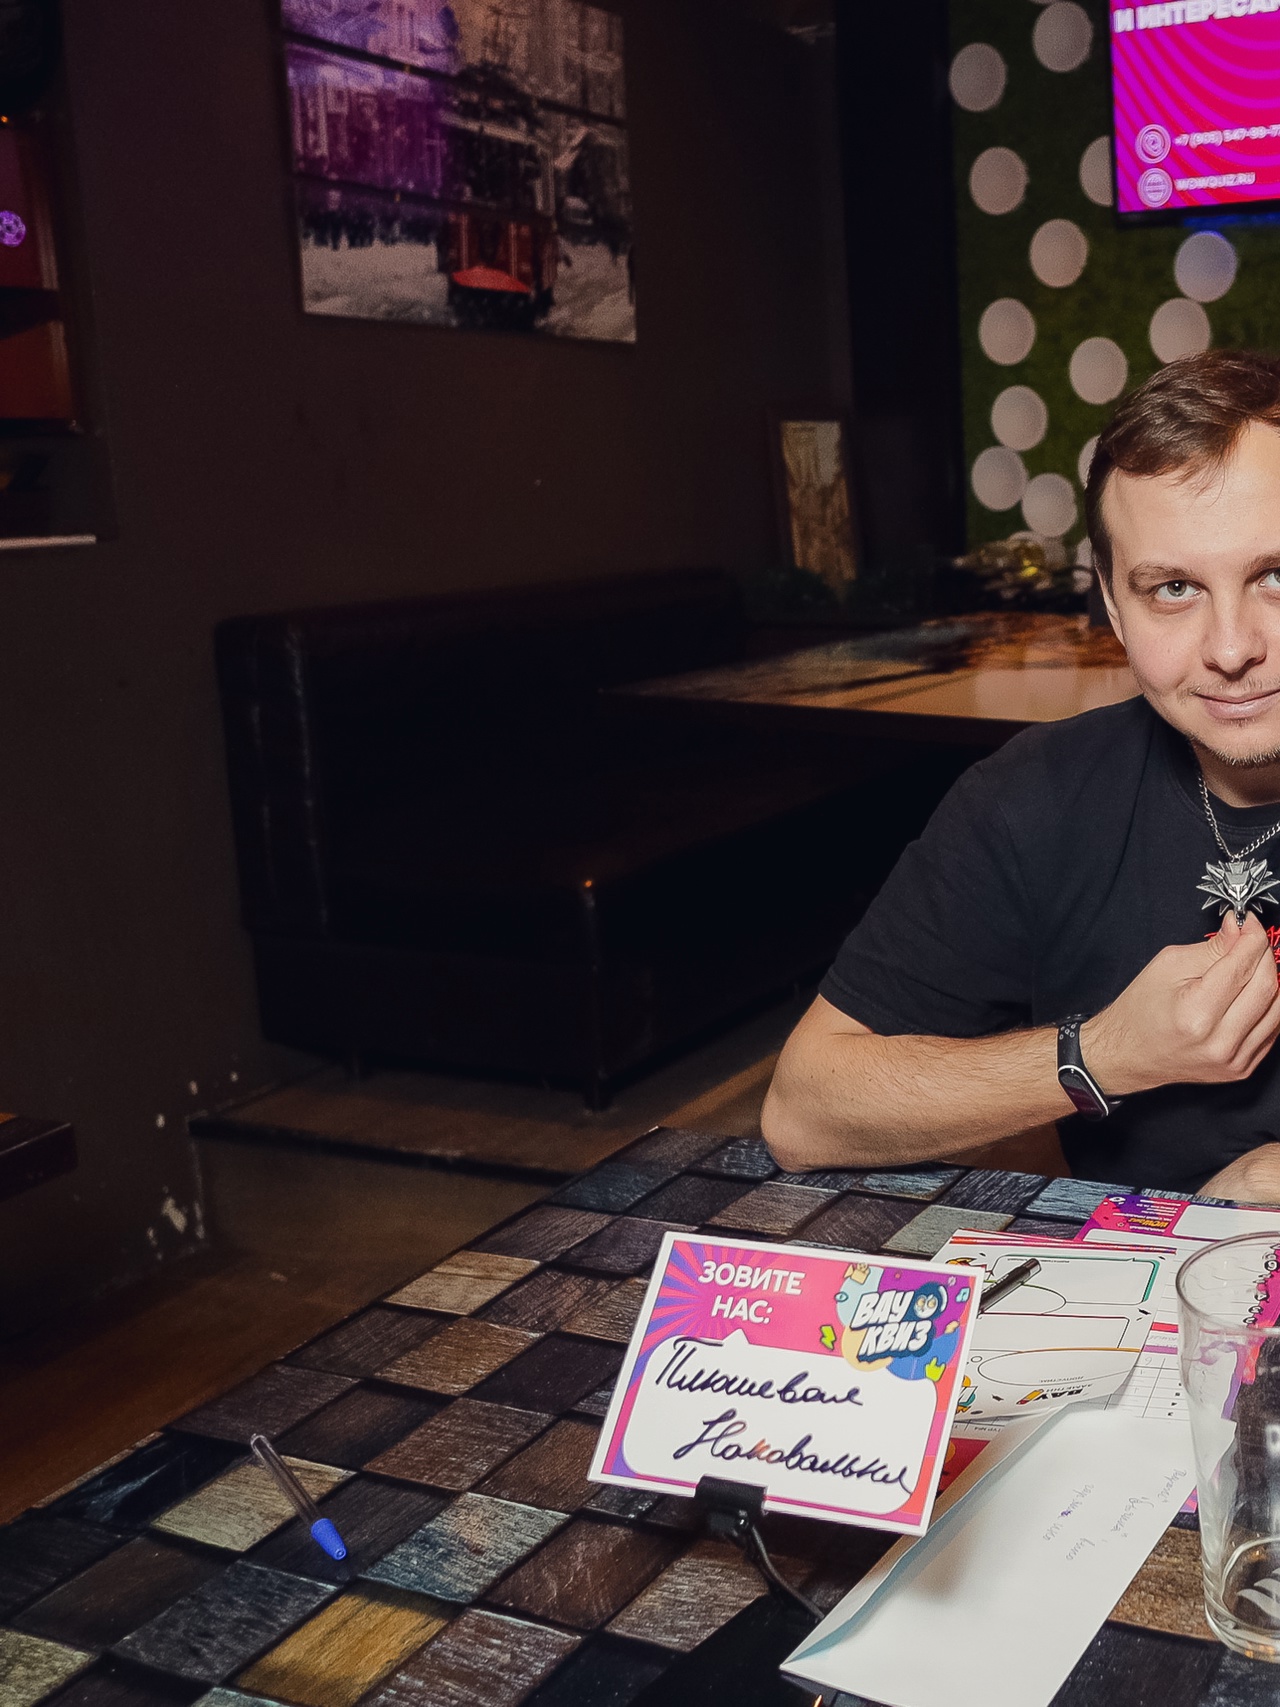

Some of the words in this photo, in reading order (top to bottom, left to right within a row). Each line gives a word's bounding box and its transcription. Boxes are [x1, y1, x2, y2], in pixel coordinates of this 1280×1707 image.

[1114, 8, 1134, 33] И
[698, 1260, 806, 1295] ЗОВИТЕ
[711, 1295, 774, 1324] НАС:
[850, 1289, 915, 1330] ВАУ
[857, 1319, 932, 1360] КВИЗ
